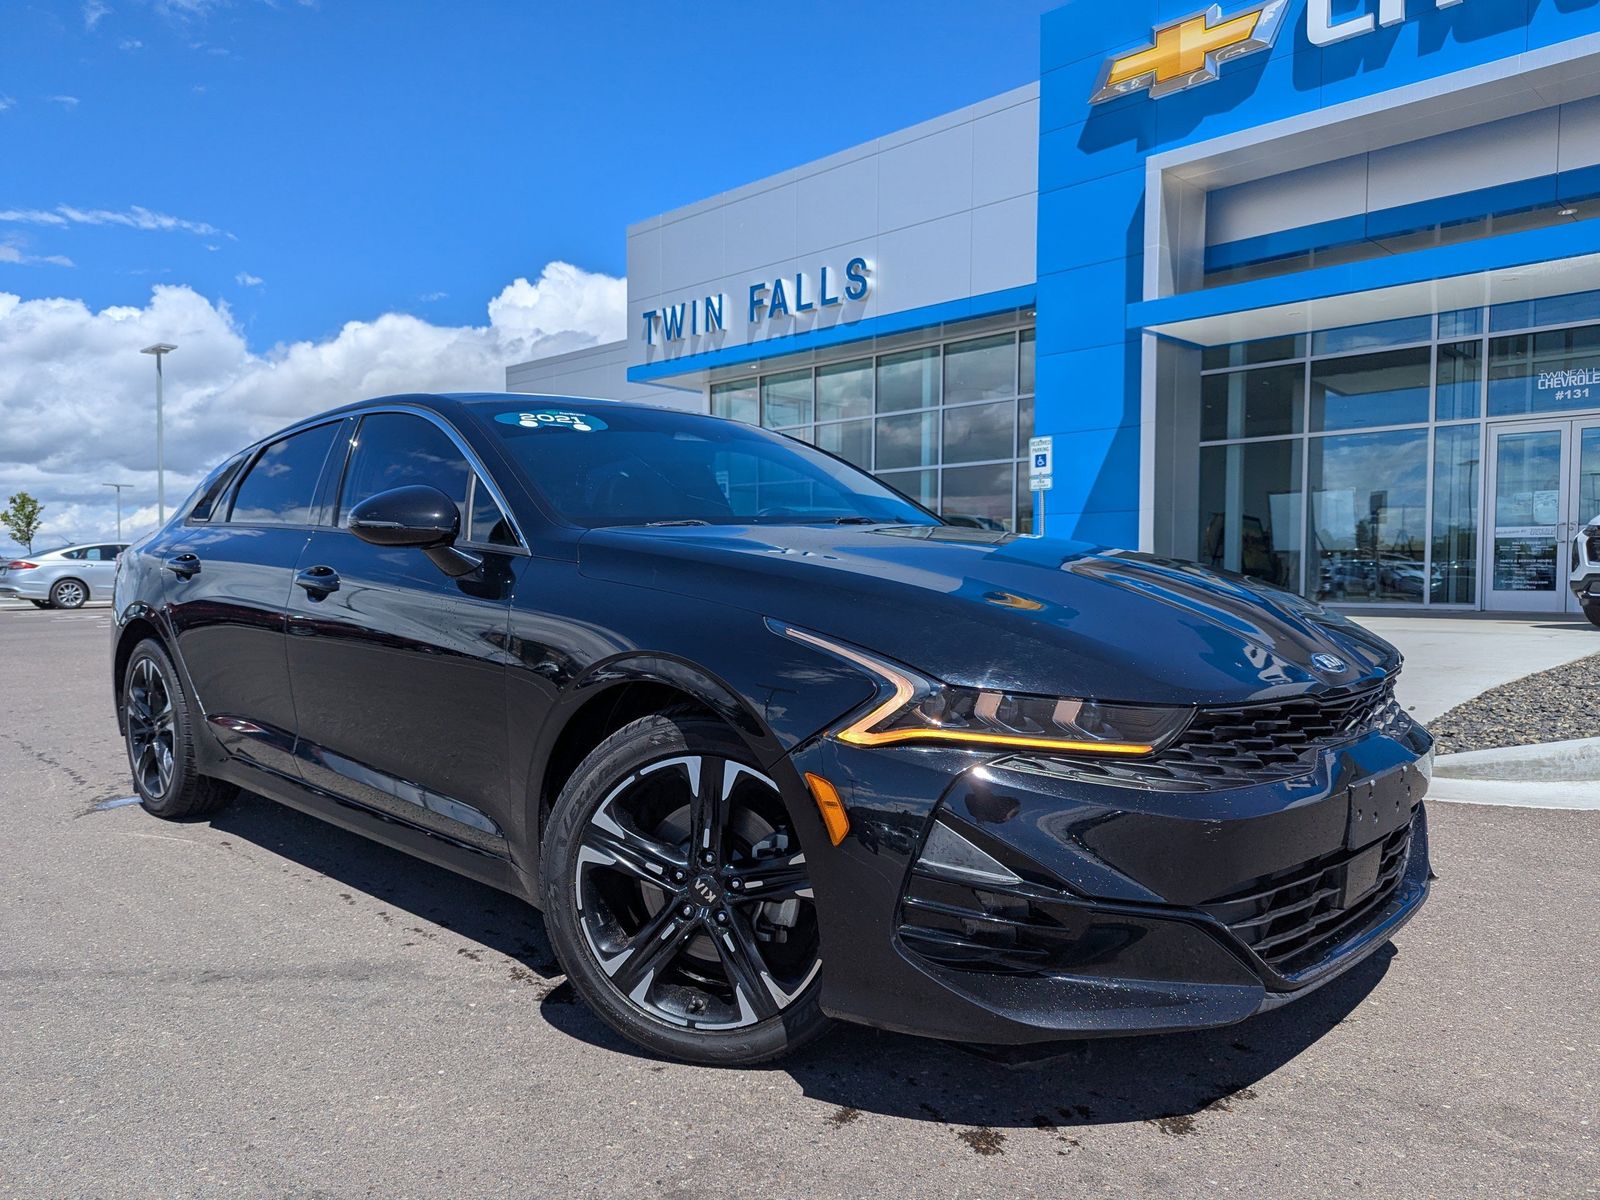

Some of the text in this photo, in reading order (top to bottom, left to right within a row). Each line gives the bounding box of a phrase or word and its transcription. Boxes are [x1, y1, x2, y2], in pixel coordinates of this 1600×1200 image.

[643, 257, 872, 346] TWIN FALLS
[1555, 388, 1589, 400] #131
[519, 413, 584, 424] 2021
[694, 878, 717, 903] KIA
